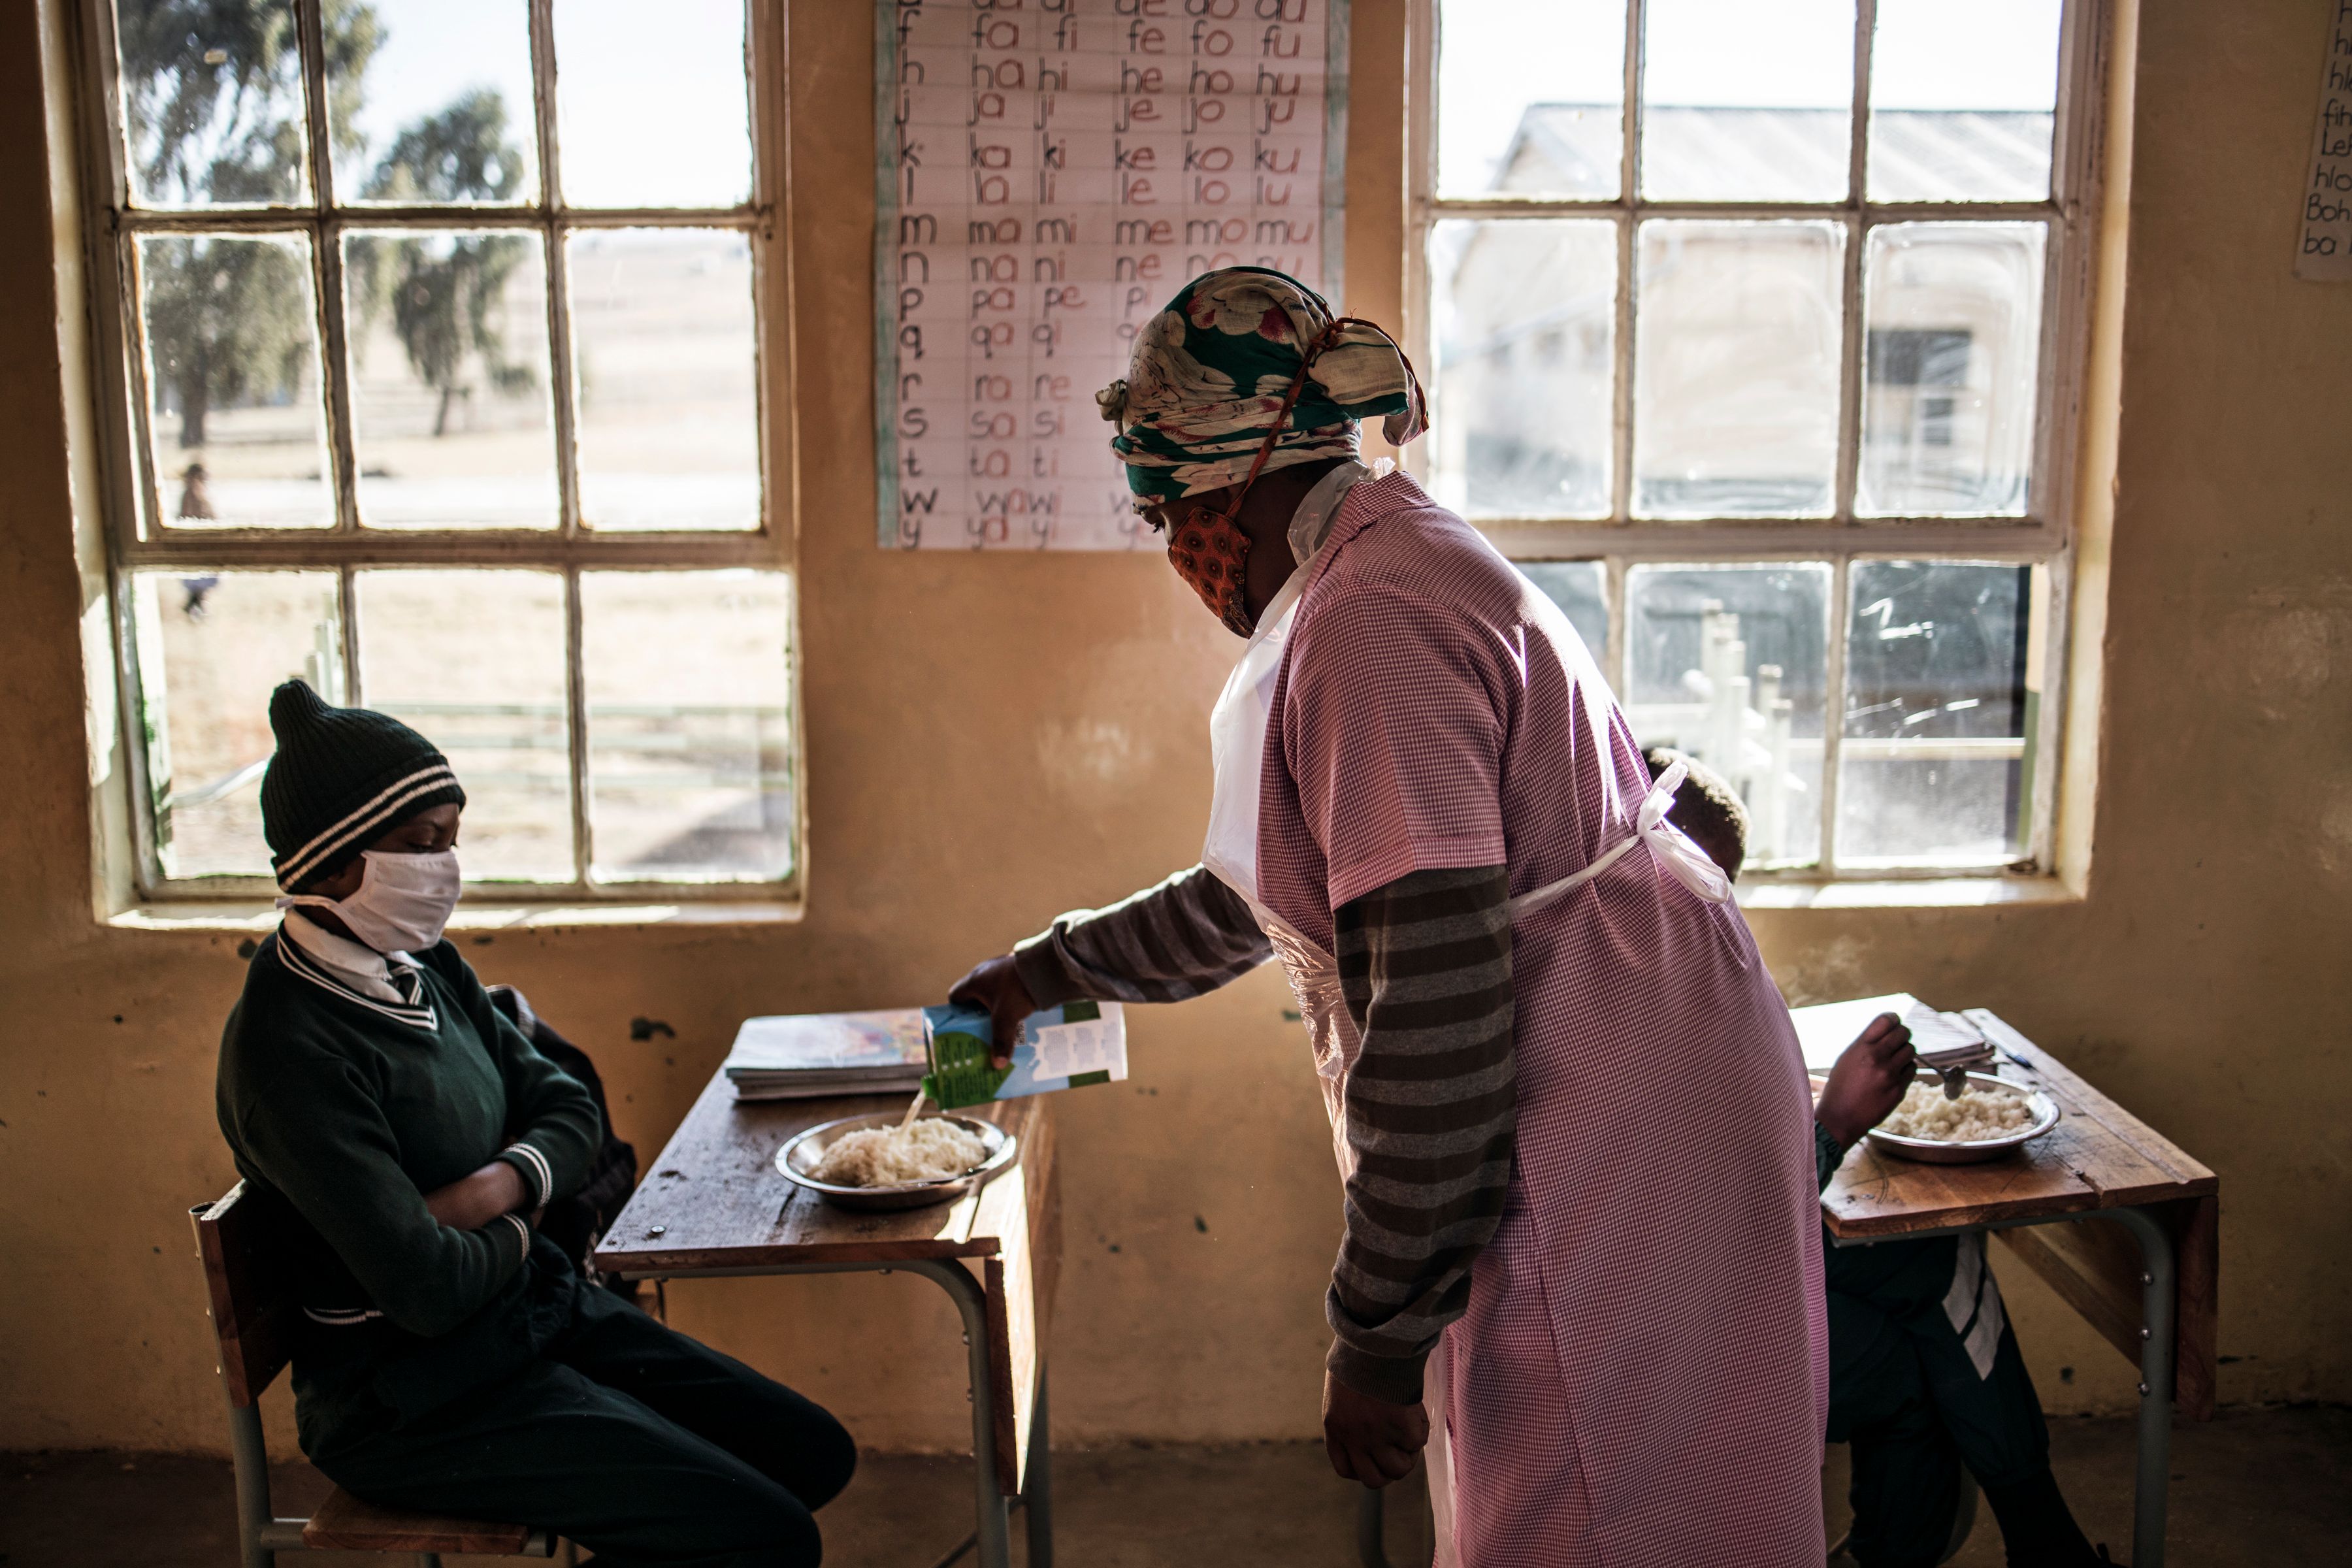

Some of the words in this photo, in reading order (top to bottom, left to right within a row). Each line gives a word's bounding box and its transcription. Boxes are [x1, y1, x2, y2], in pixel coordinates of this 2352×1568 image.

[897, 9, 921, 45] f
[972, 12, 1019, 50] fa
[1053, 13, 1077, 52] fi
[1127, 19, 1166, 54] fe
[1190, 20, 1233, 56] fo
[1262, 24, 1300, 58] fu
[902, 48, 924, 84] h
[972, 52, 1025, 90] ha
[1038, 56, 1068, 91] hi
[1121, 59, 1163, 94] he
[1189, 60, 1234, 94] ho
[1256, 63, 1301, 95] hu
[895, 89, 910, 125] j
[966, 90, 1005, 127] ja
[1034, 93, 1054, 130] ji
[1115, 97, 1162, 133] je
[1183, 98, 1225, 134] jo
[1256, 98, 1295, 135] ju
[901, 126, 921, 167] k
[970, 131, 1011, 170] ka
[1043, 131, 1066, 171] ki
[1115, 138, 1157, 171] ke
[1183, 139, 1233, 172] ko
[1254, 138, 1301, 175] ku
[974, 170, 1009, 206] la
[1039, 170, 1056, 205] li
[1122, 172, 1157, 206] le
[1194, 175, 1230, 206] lo
[1256, 175, 1292, 206] lu
[901, 214, 937, 245] m
[968, 218, 1021, 246] ma
[1036, 213, 1077, 245] mi
[1115, 220, 1175, 246] me
[1186, 218, 1249, 246] mo
[1255, 220, 1314, 246] mu
[901, 251, 929, 284] n
[971, 253, 1019, 284] na
[1035, 250, 1066, 283] ni
[1115, 253, 1162, 283] ne
[900, 287, 924, 322] p
[972, 287, 1015, 321] pa
[1043, 286, 1087, 319] pe
[902, 372, 923, 401] r
[975, 374, 1012, 402] ra
[1035, 374, 1071, 402] re
[902, 447, 922, 478] t
[902, 521, 922, 551] y
